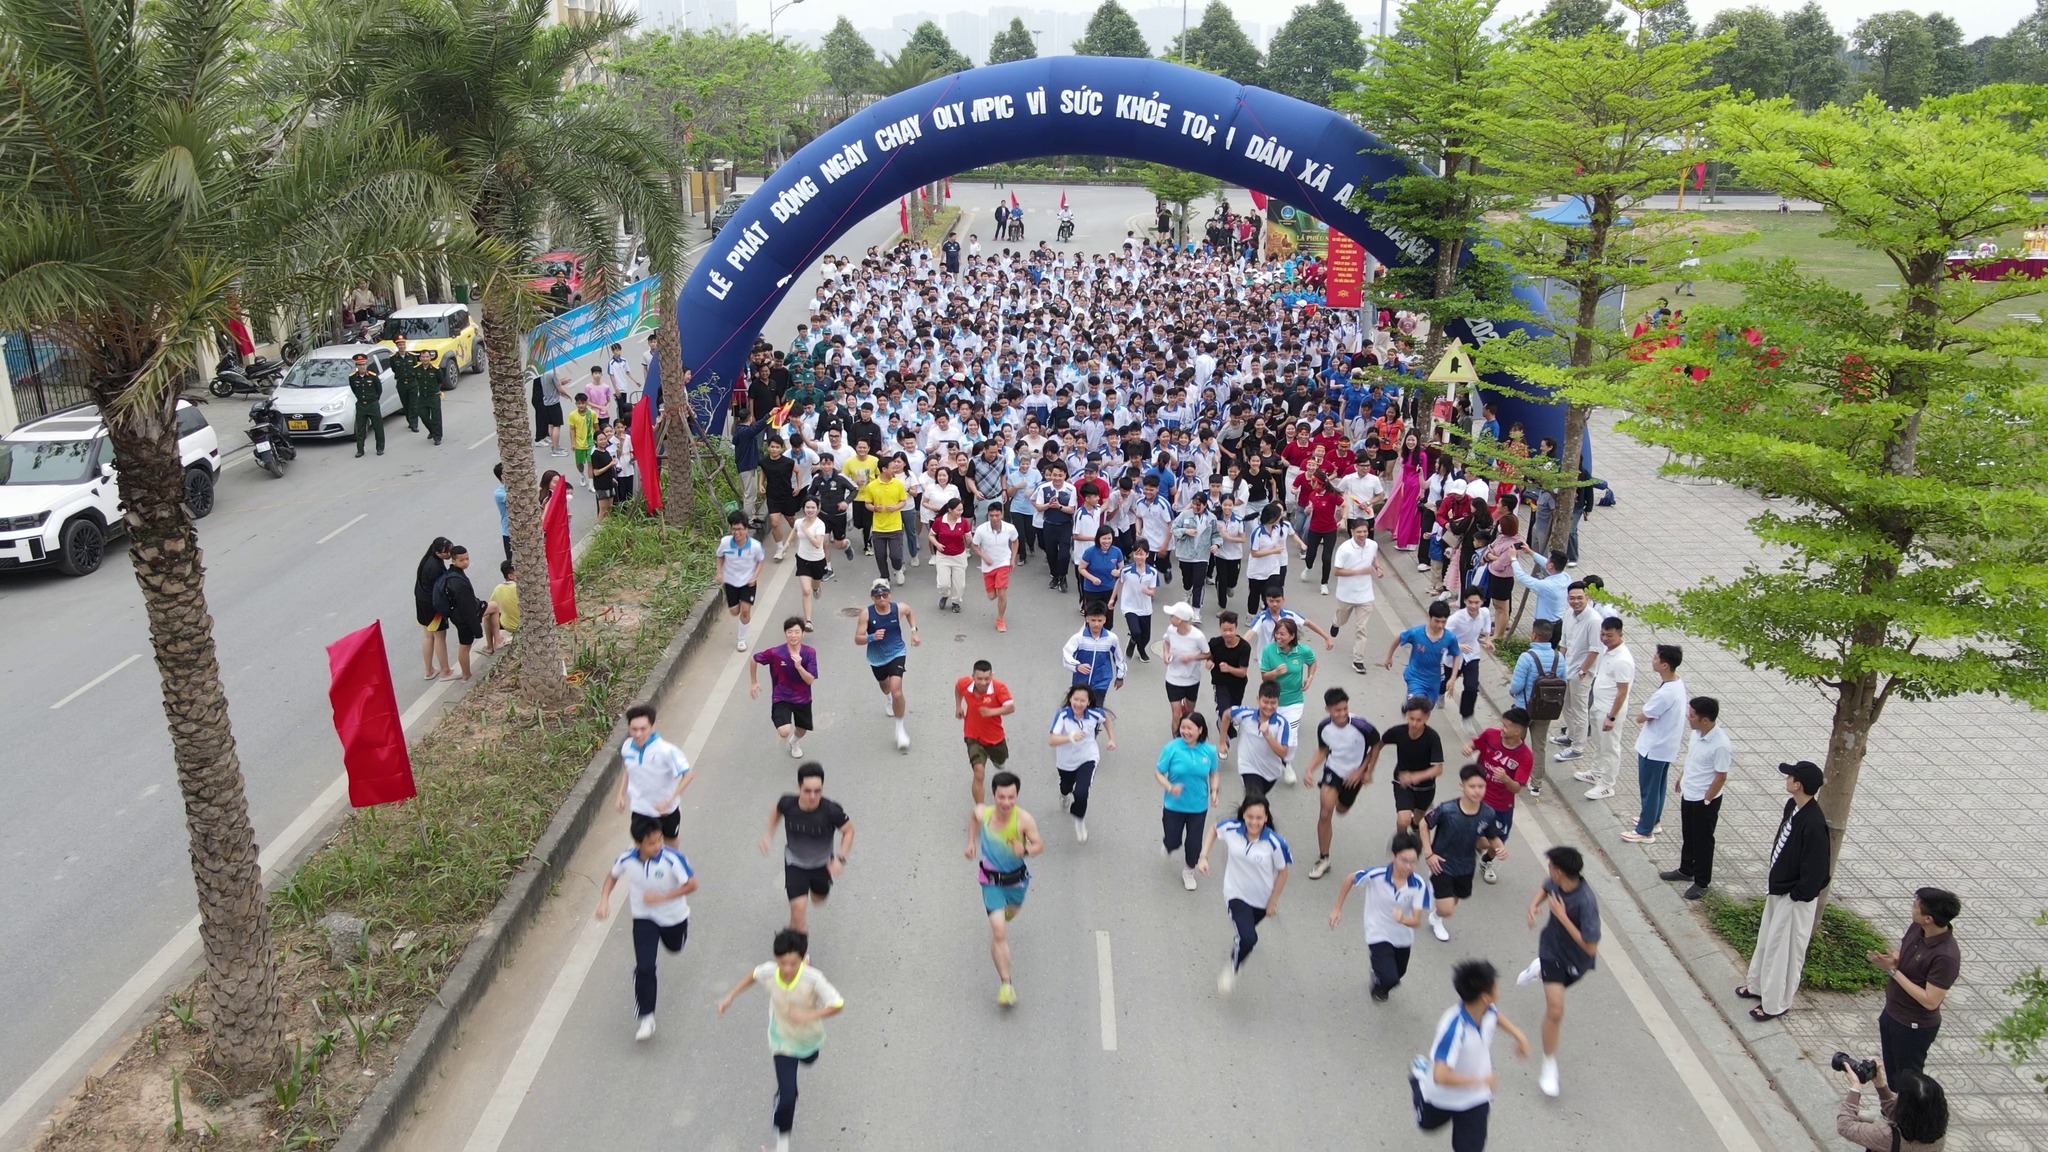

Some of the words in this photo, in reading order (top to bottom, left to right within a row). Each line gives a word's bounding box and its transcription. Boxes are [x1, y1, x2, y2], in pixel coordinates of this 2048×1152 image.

[706, 268, 734, 301] LỄ
[726, 220, 770, 272] PHÁT
[770, 175, 820, 224] ĐỘNG
[819, 139, 869, 184] NGÀY
[874, 114, 923, 152] CHẠY
[1026, 86, 1047, 116] VÌ
[1060, 85, 1104, 117] SỨC
[1115, 91, 1171, 128] KHỎE
[1244, 134, 1294, 173] DÂN
[1297, 158, 1334, 193] XÃ
[1463, 317, 1500, 349] 202
[1492, 750, 1509, 766] 24
